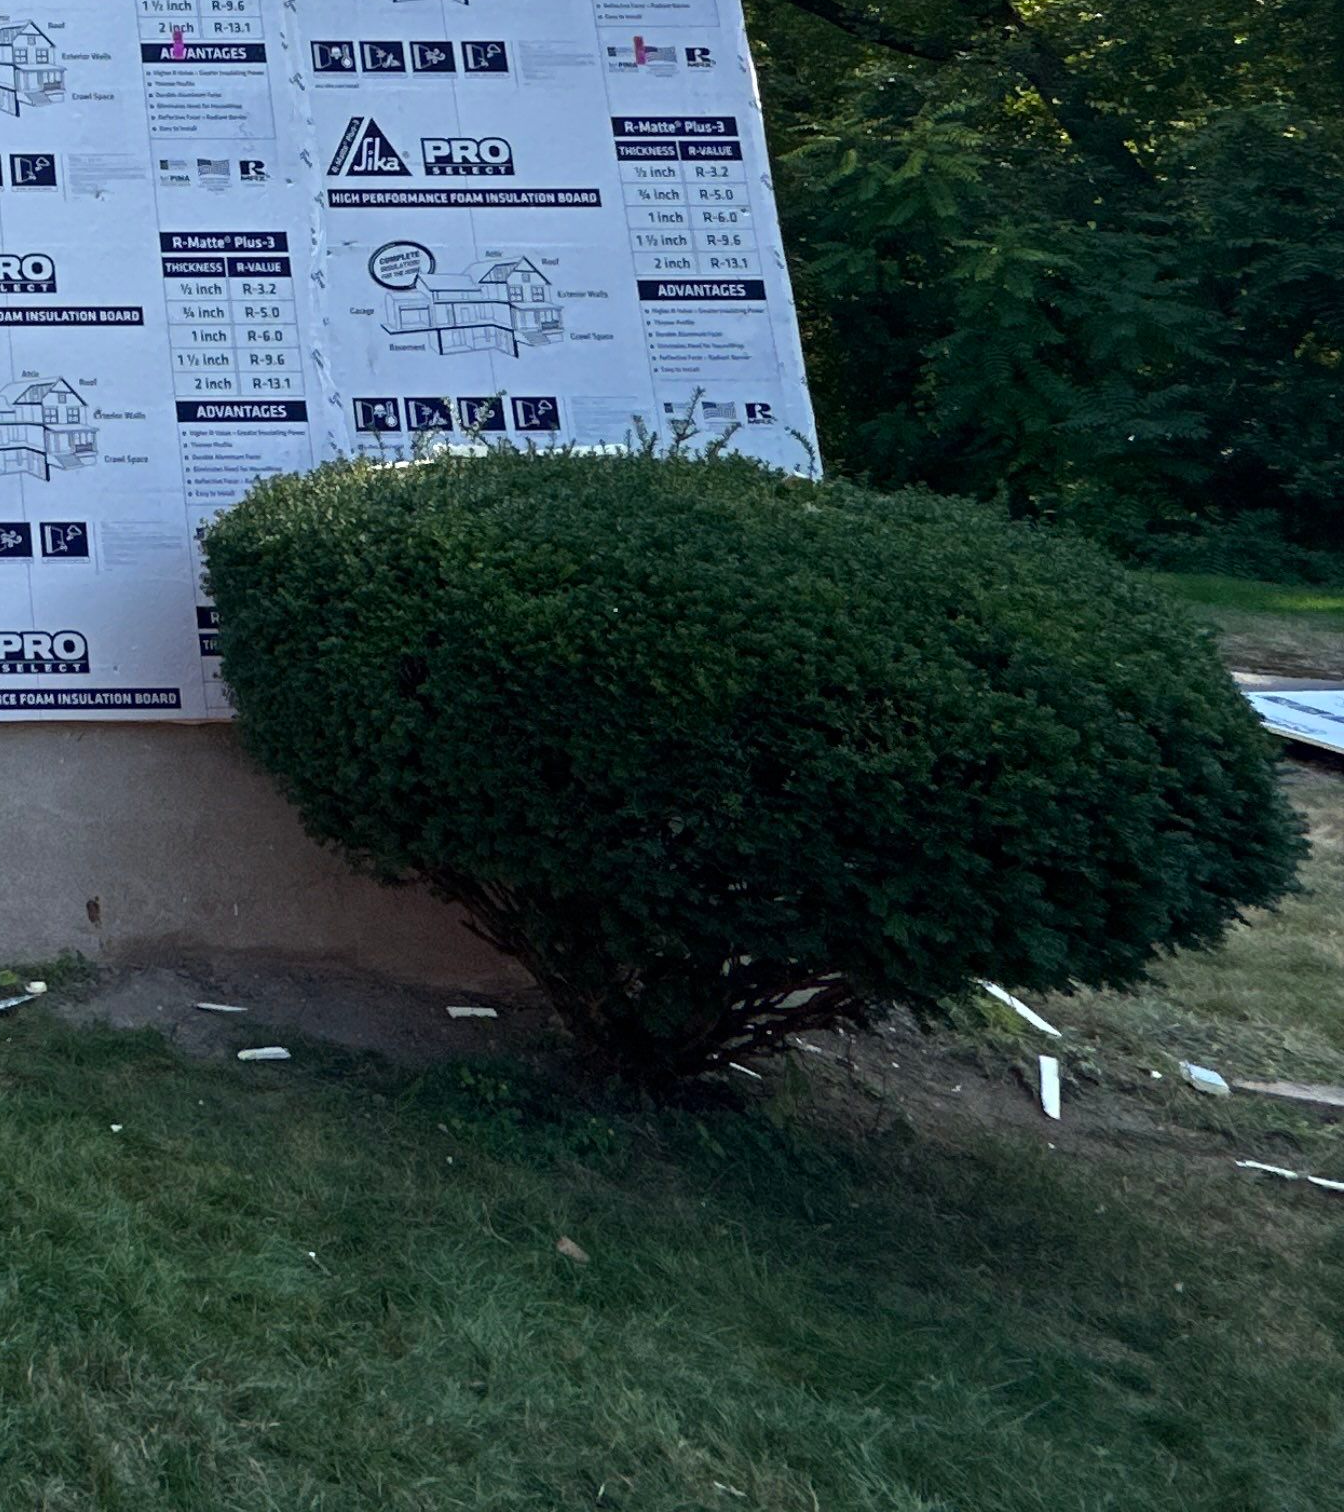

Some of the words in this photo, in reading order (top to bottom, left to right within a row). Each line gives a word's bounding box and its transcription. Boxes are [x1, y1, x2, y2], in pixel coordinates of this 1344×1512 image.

[684, 120, 725, 133] Plus-3
[359, 137, 400, 171] Sika
[423, 140, 509, 163] PRO
[617, 145, 674, 156] THICKNESS
[688, 145, 733, 156] R-VALUE
[433, 164, 505, 174] SELECT
[331, 192, 360, 203] HIGH
[362, 192, 448, 203] PERFORMANCE
[450, 192, 484, 203] FOAM
[485, 192, 555, 203] INSULATION
[557, 192, 597, 203] BOARD
[234, 236, 275, 248] Plus-3
[164, 262, 221, 272] THICKNESS
[236, 262, 281, 272] R-VALUE
[658, 284, 746, 296] ADVANTAGES
[196, 405, 287, 418] ADVANTAGES
[2, 663, 80, 672] SELECT
[19, 693, 55, 705] FOAM
[57, 692, 132, 705] INSULATION
[134, 692, 176, 704] BOARD
